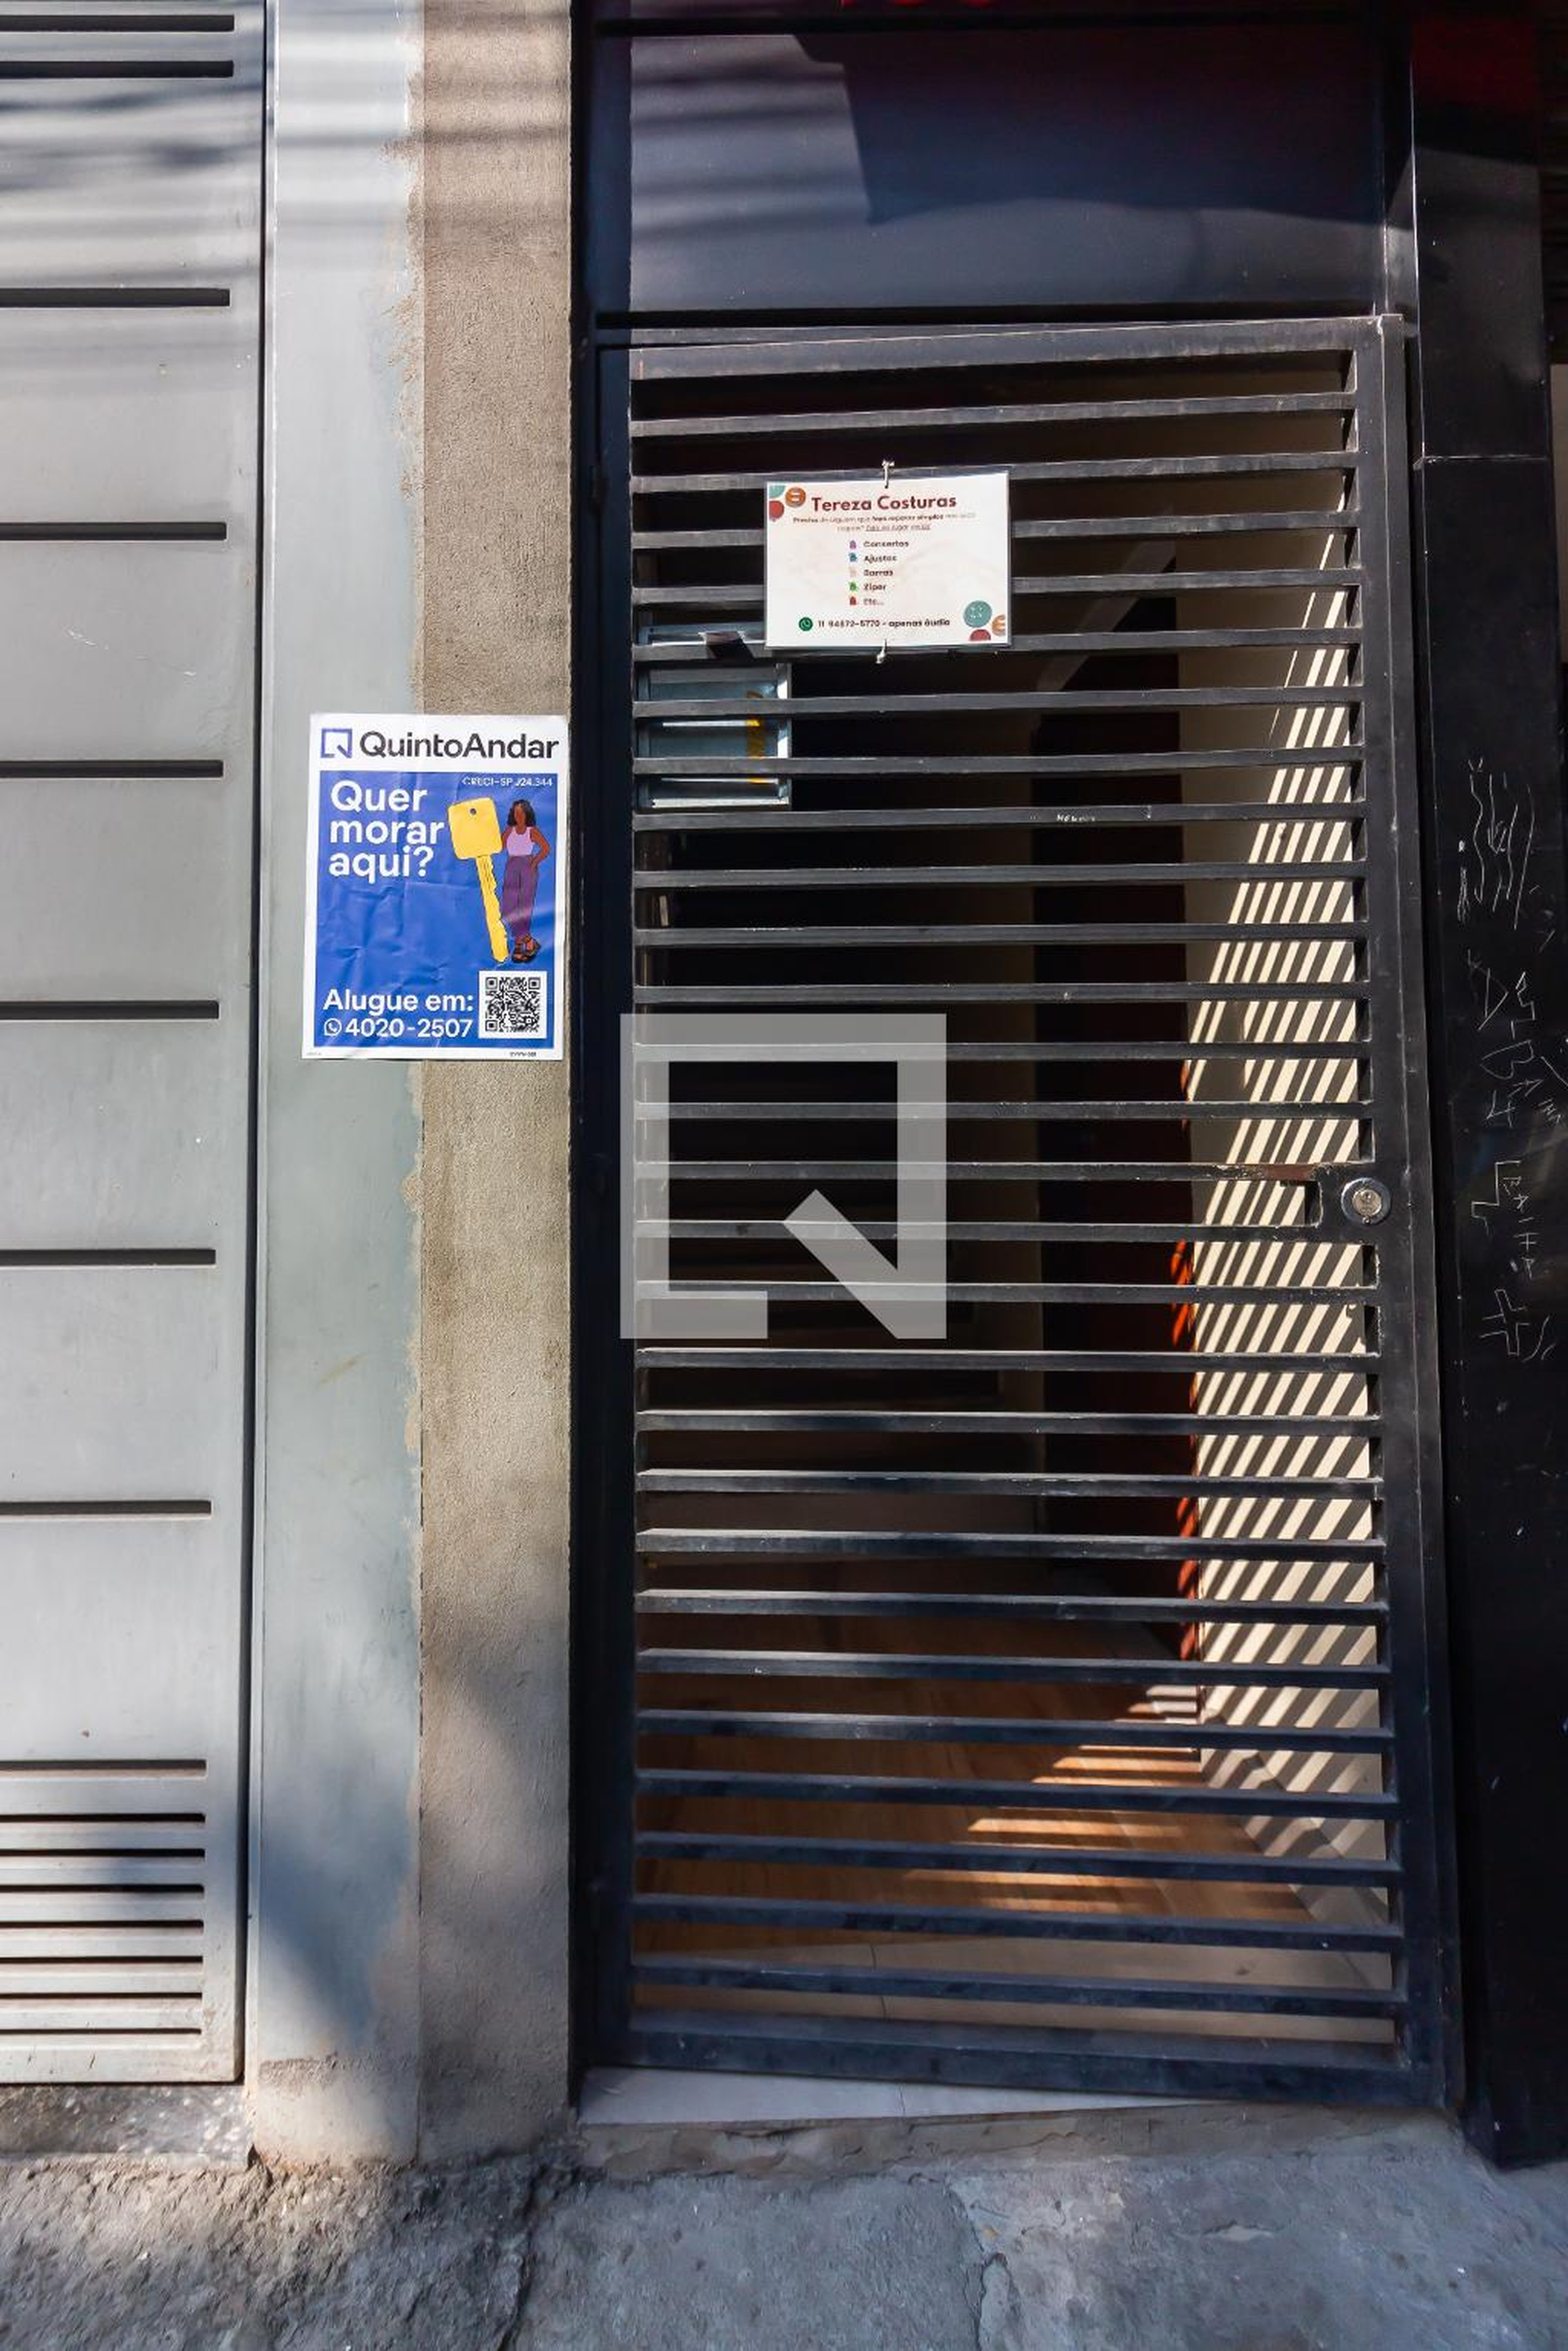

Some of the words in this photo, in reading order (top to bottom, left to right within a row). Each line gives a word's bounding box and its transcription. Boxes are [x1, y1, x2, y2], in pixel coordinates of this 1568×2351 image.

[811, 497, 871, 512] Tereza
[877, 495, 956, 510] Costuras
[360, 731, 559, 758] QuintoAndar
[330, 779, 428, 813] Quer
[330, 819, 445, 844] morar
[329, 845, 434, 883] aqui?
[323, 989, 417, 1016] Alugue
[425, 994, 474, 1012] em:
[345, 1018, 473, 1038] 4020-2507
